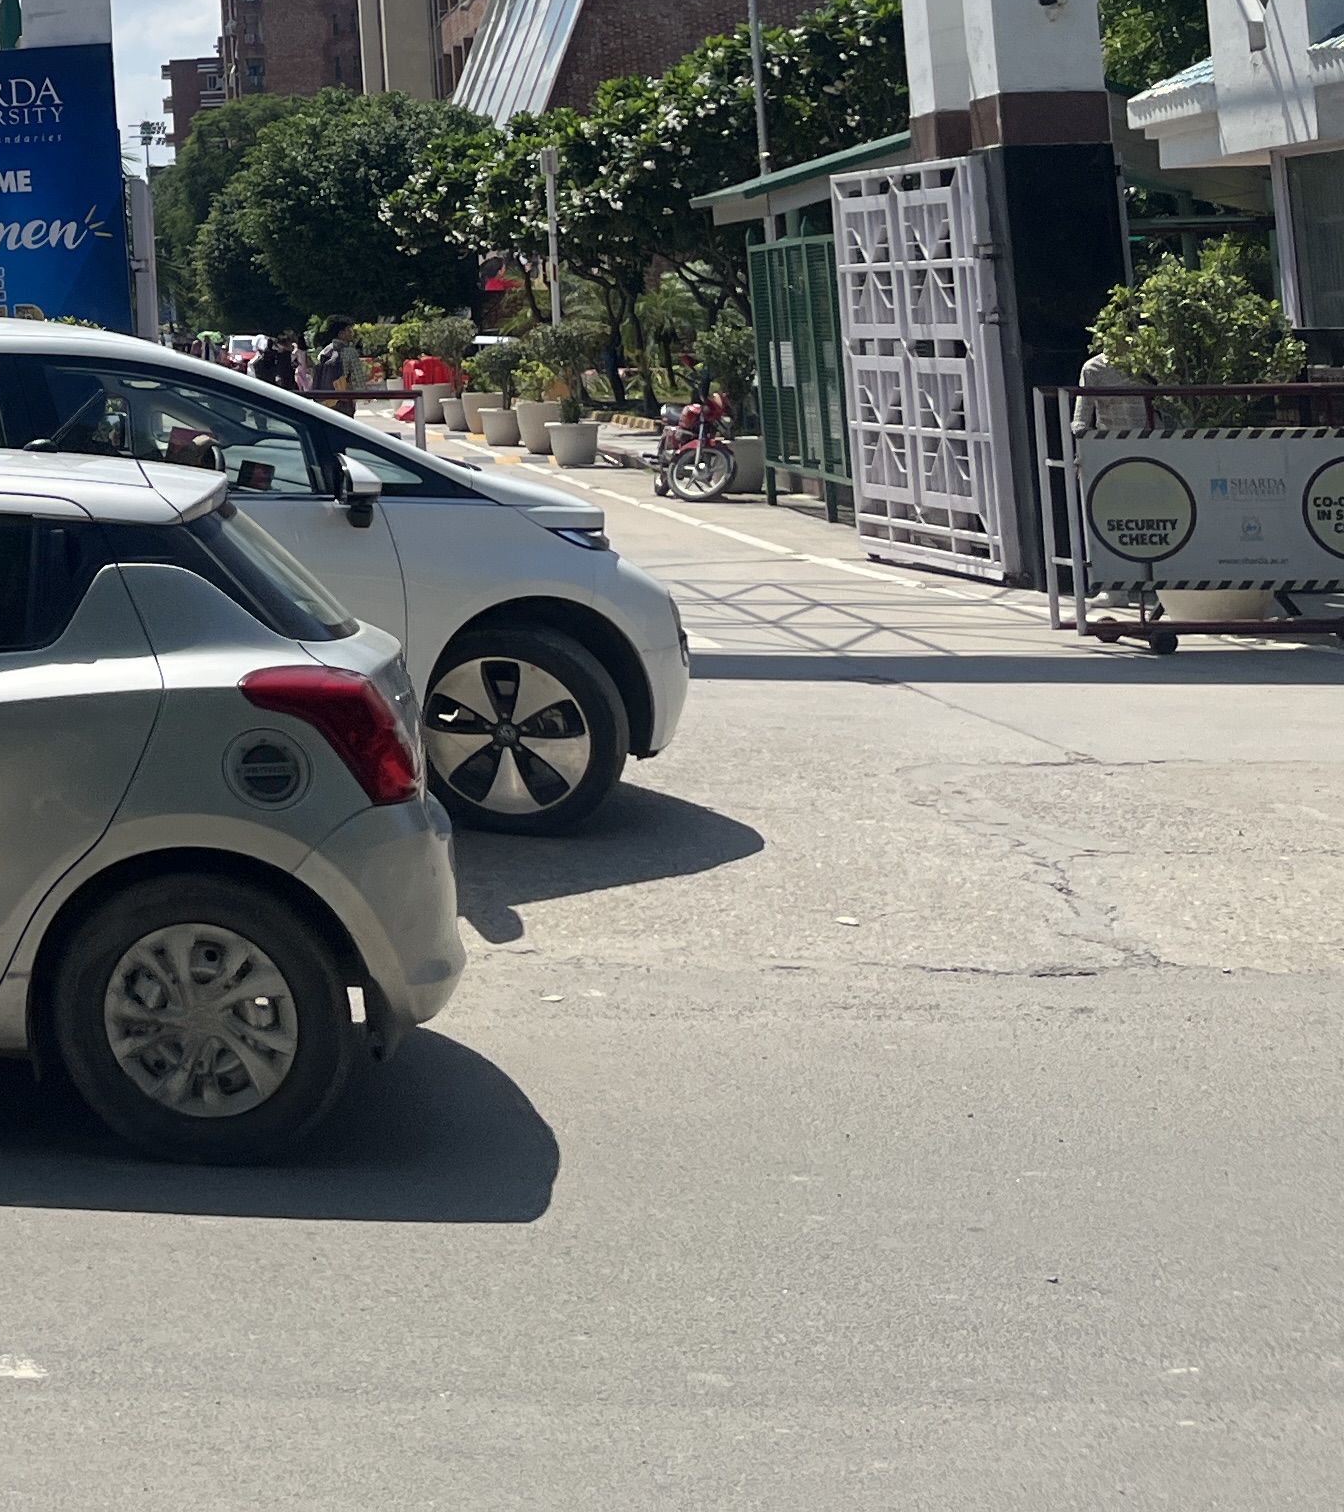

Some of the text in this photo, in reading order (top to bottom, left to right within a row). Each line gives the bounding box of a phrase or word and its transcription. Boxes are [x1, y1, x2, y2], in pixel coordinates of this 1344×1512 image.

[1230, 478, 1286, 489] SHARDA
[1316, 509, 1332, 521] IN
[1106, 518, 1178, 532] SECURITY
[1118, 532, 1171, 546] CHECK
